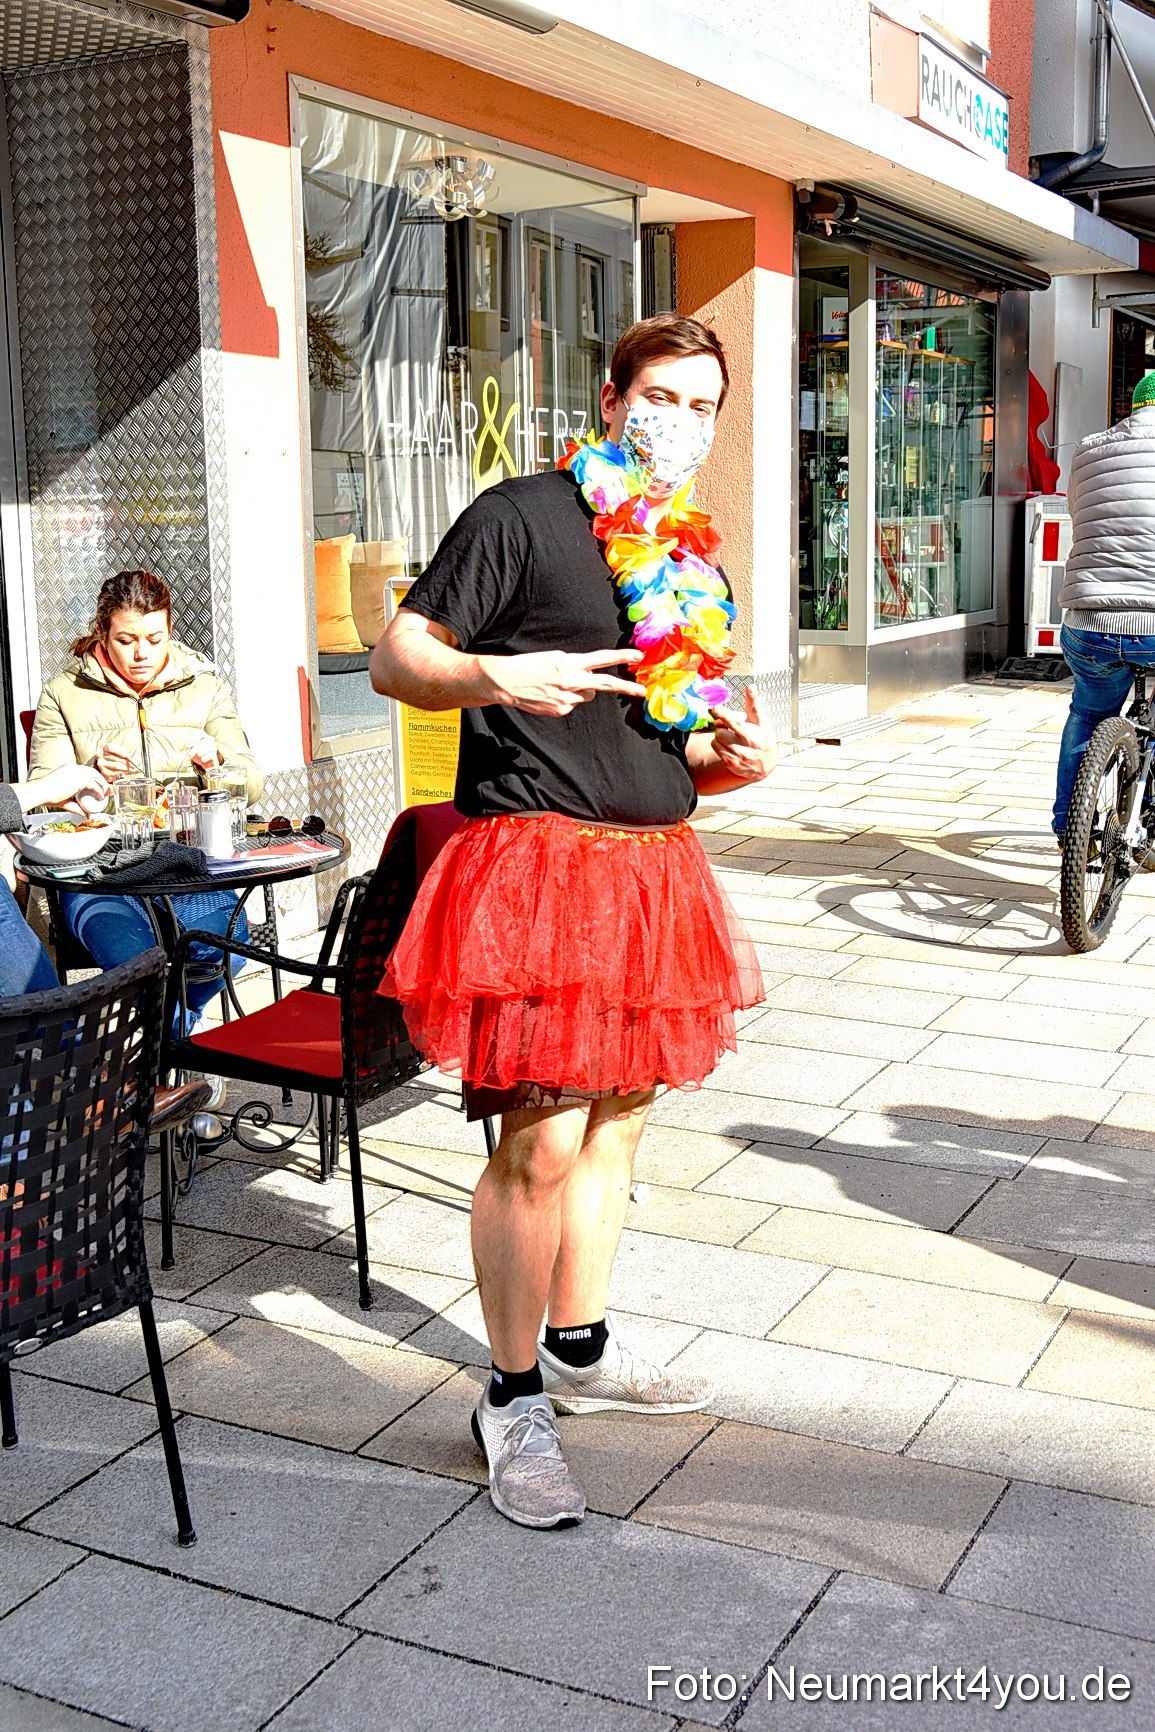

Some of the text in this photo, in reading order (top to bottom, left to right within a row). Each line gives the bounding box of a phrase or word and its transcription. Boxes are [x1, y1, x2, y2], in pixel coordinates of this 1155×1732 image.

[384, 376, 587, 481] HAAR & HERZ
[408, 722, 457, 733] Flammkuchen
[411, 787, 453, 798] Sandwiches
[559, 1328, 592, 1340] PUMA
